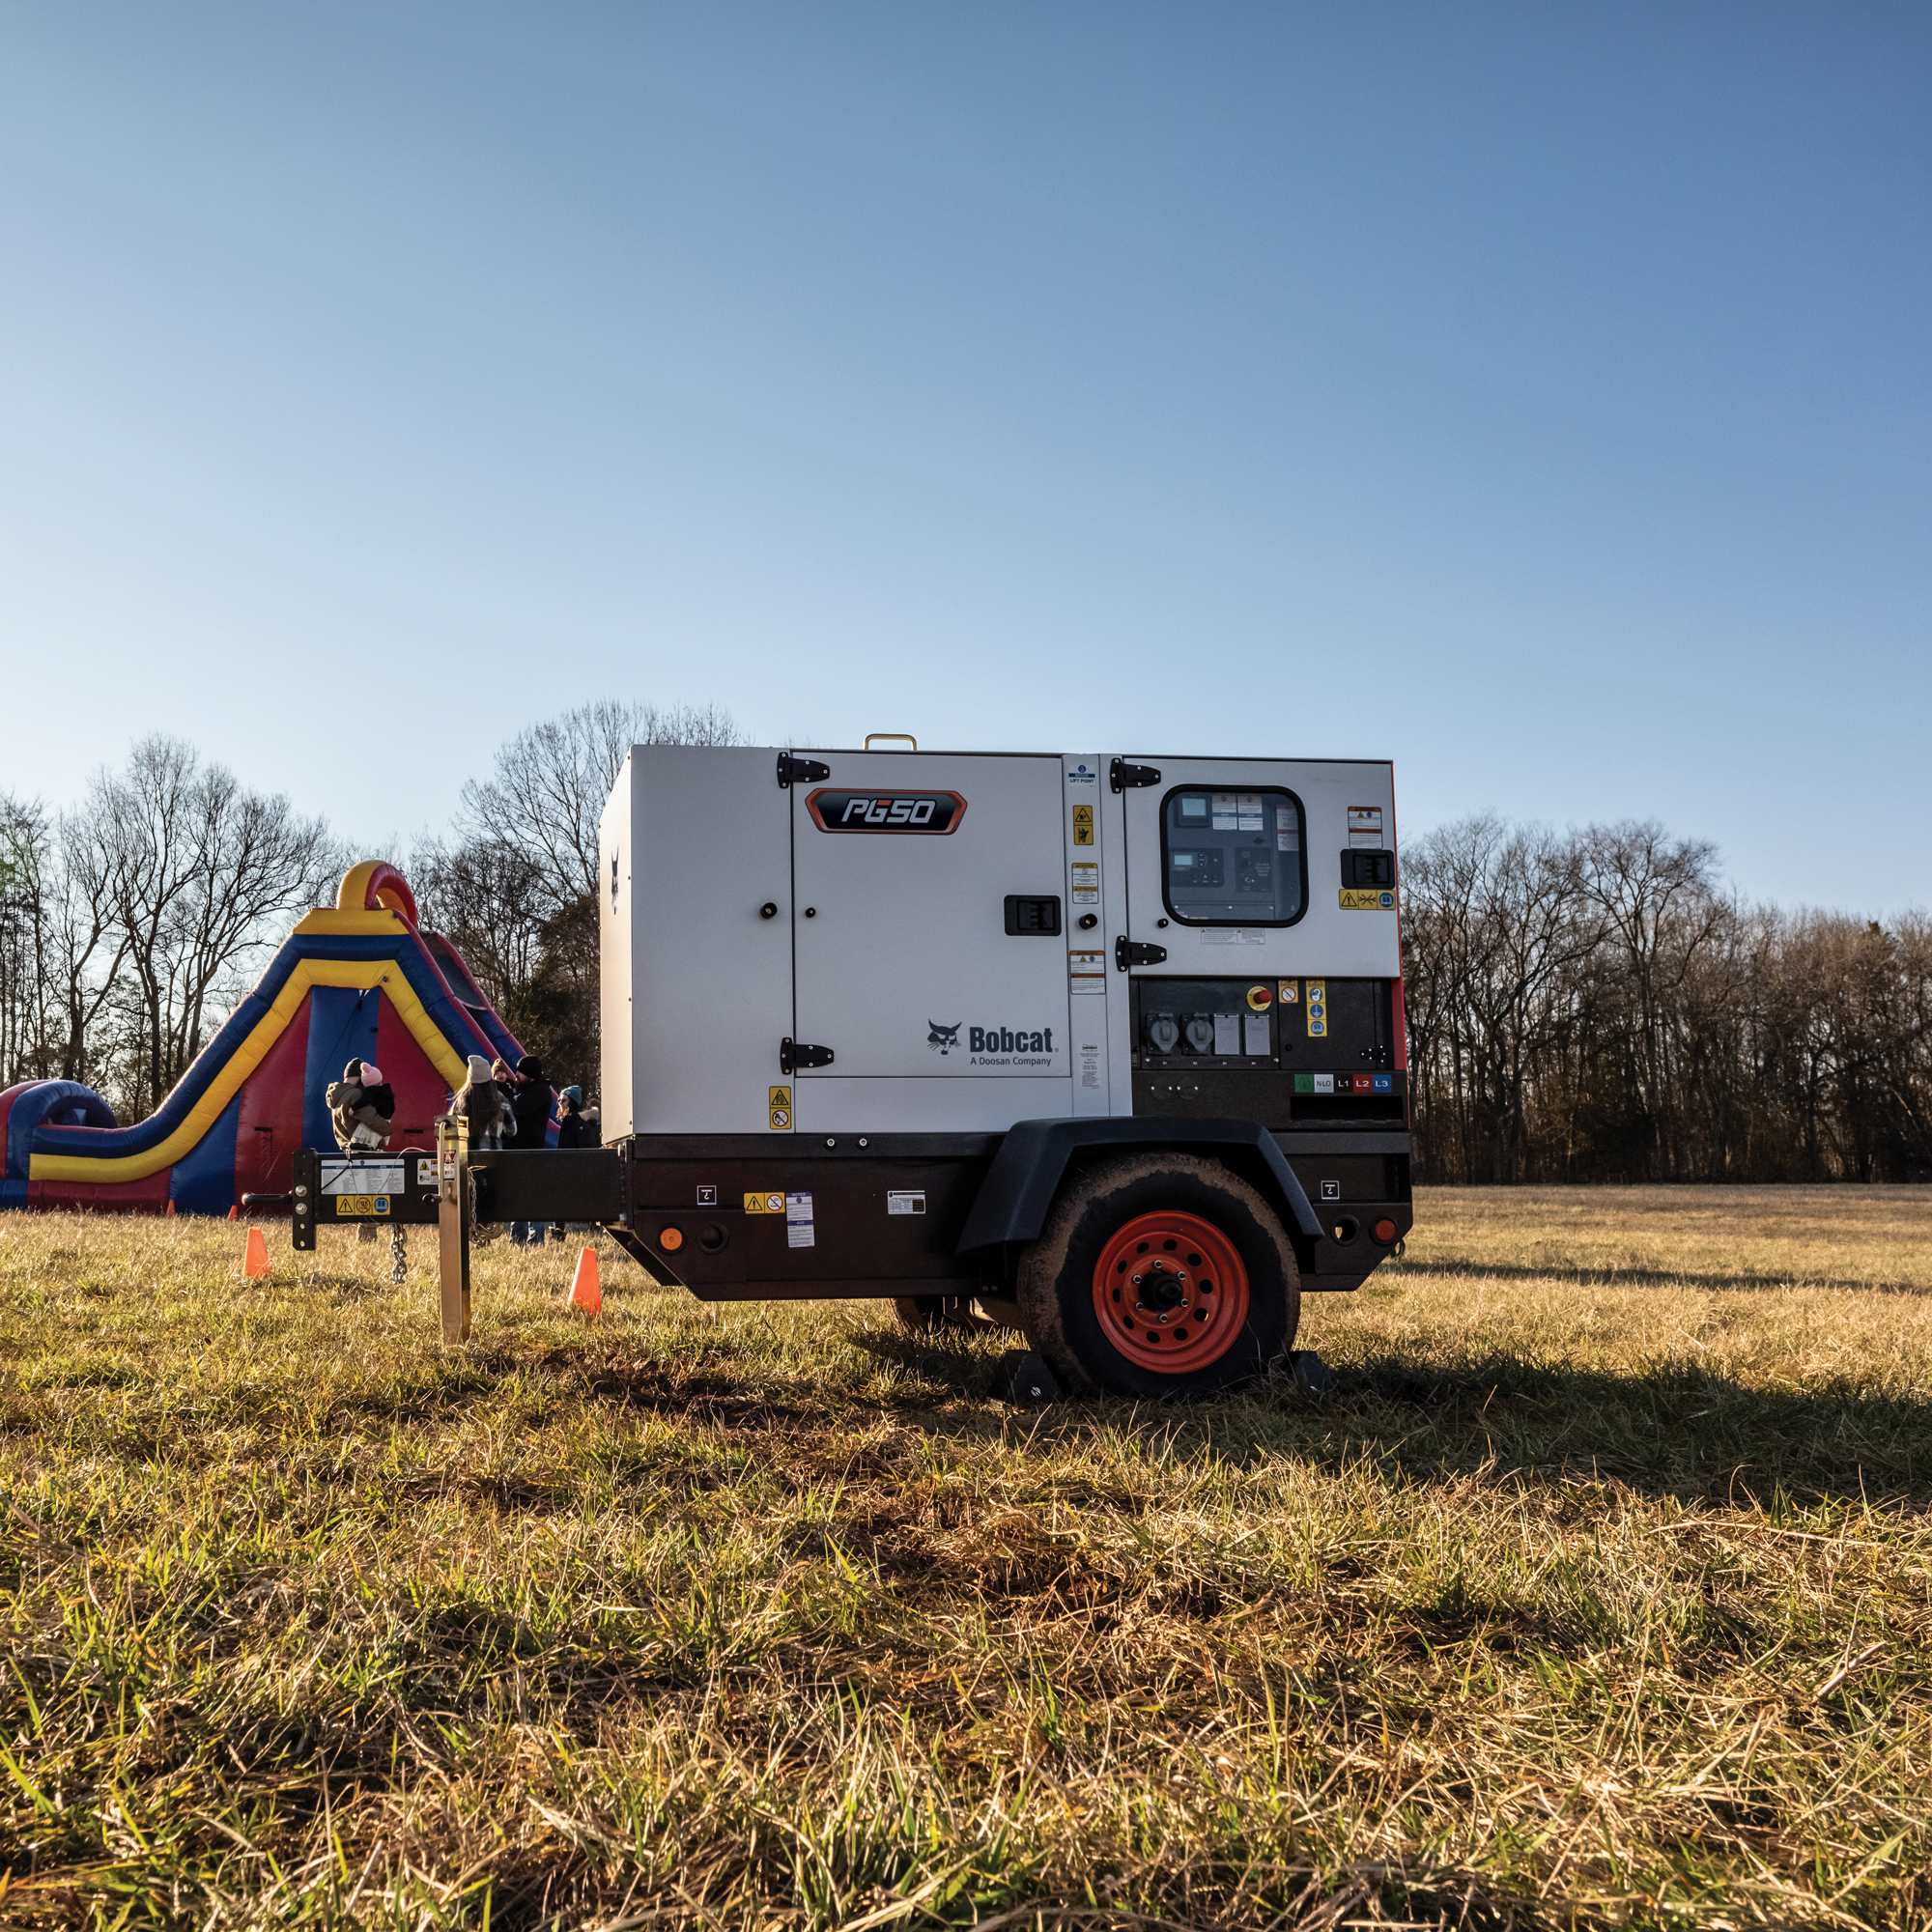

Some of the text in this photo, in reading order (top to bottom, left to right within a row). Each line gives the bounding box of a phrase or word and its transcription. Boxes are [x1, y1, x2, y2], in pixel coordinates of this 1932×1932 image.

[841, 799, 936, 823] PG50
[970, 1027, 1053, 1053] Bobcat
[970, 1057, 1051, 1066] A Doosan Company
